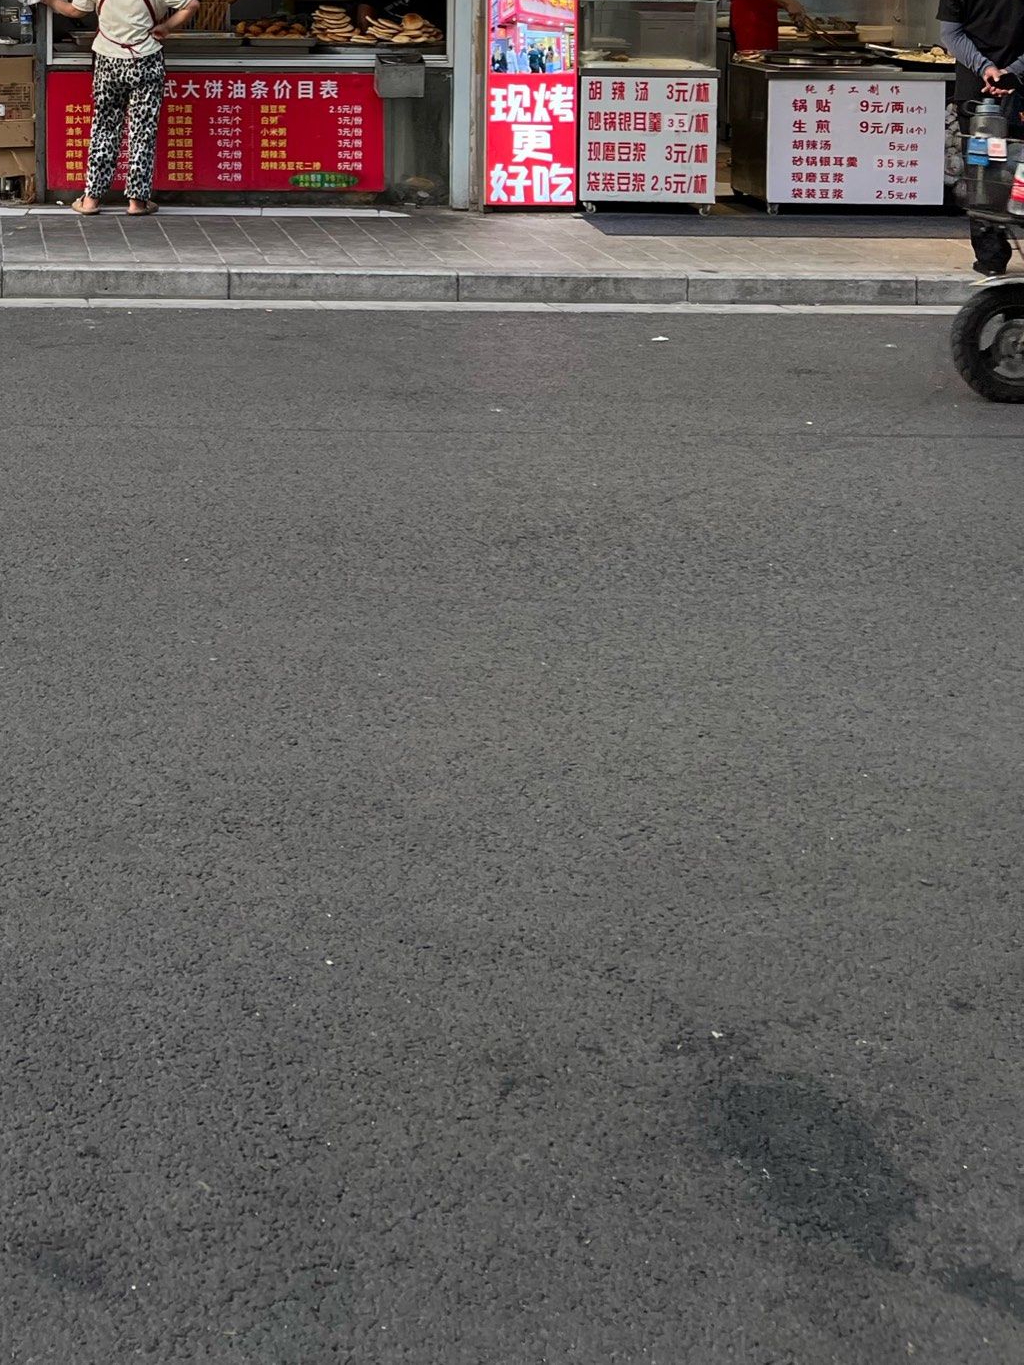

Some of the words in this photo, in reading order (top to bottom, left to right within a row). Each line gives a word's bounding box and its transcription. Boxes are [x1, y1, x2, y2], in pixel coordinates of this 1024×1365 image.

[588, 81, 649, 102] 胡辣汤
[666, 82, 710, 103] 3元/杯
[805, 84, 902, 96] 纯手工制作
[217, 104, 242, 113] 2元/个
[490, 82, 575, 123] 现烤
[792, 98, 832, 114] 锅贴
[209, 116, 242, 125] 3.5元/个
[588, 111, 662, 133] 砂锅银耳羹
[792, 119, 831, 134] 生煎
[209, 127, 242, 136] 3.5元/个
[511, 123, 554, 163] 更
[792, 139, 832, 151] 胡辣汤
[888, 141, 919, 152] 5元/份
[587, 141, 646, 162] 现磨豆浆
[665, 143, 708, 164] 3元/杯
[792, 156, 858, 168] 砂锅银耳羹
[490, 163, 574, 203] 好吃
[587, 171, 646, 193] 袋装豆浆
[651, 173, 708, 194] 2.5元/杯
[791, 172, 845, 184] 现磨豆浆
[887, 174, 918, 184] 3元/杯
[791, 187, 844, 200] 袋装豆浆
[875, 189, 918, 200] 2.5元/杯
